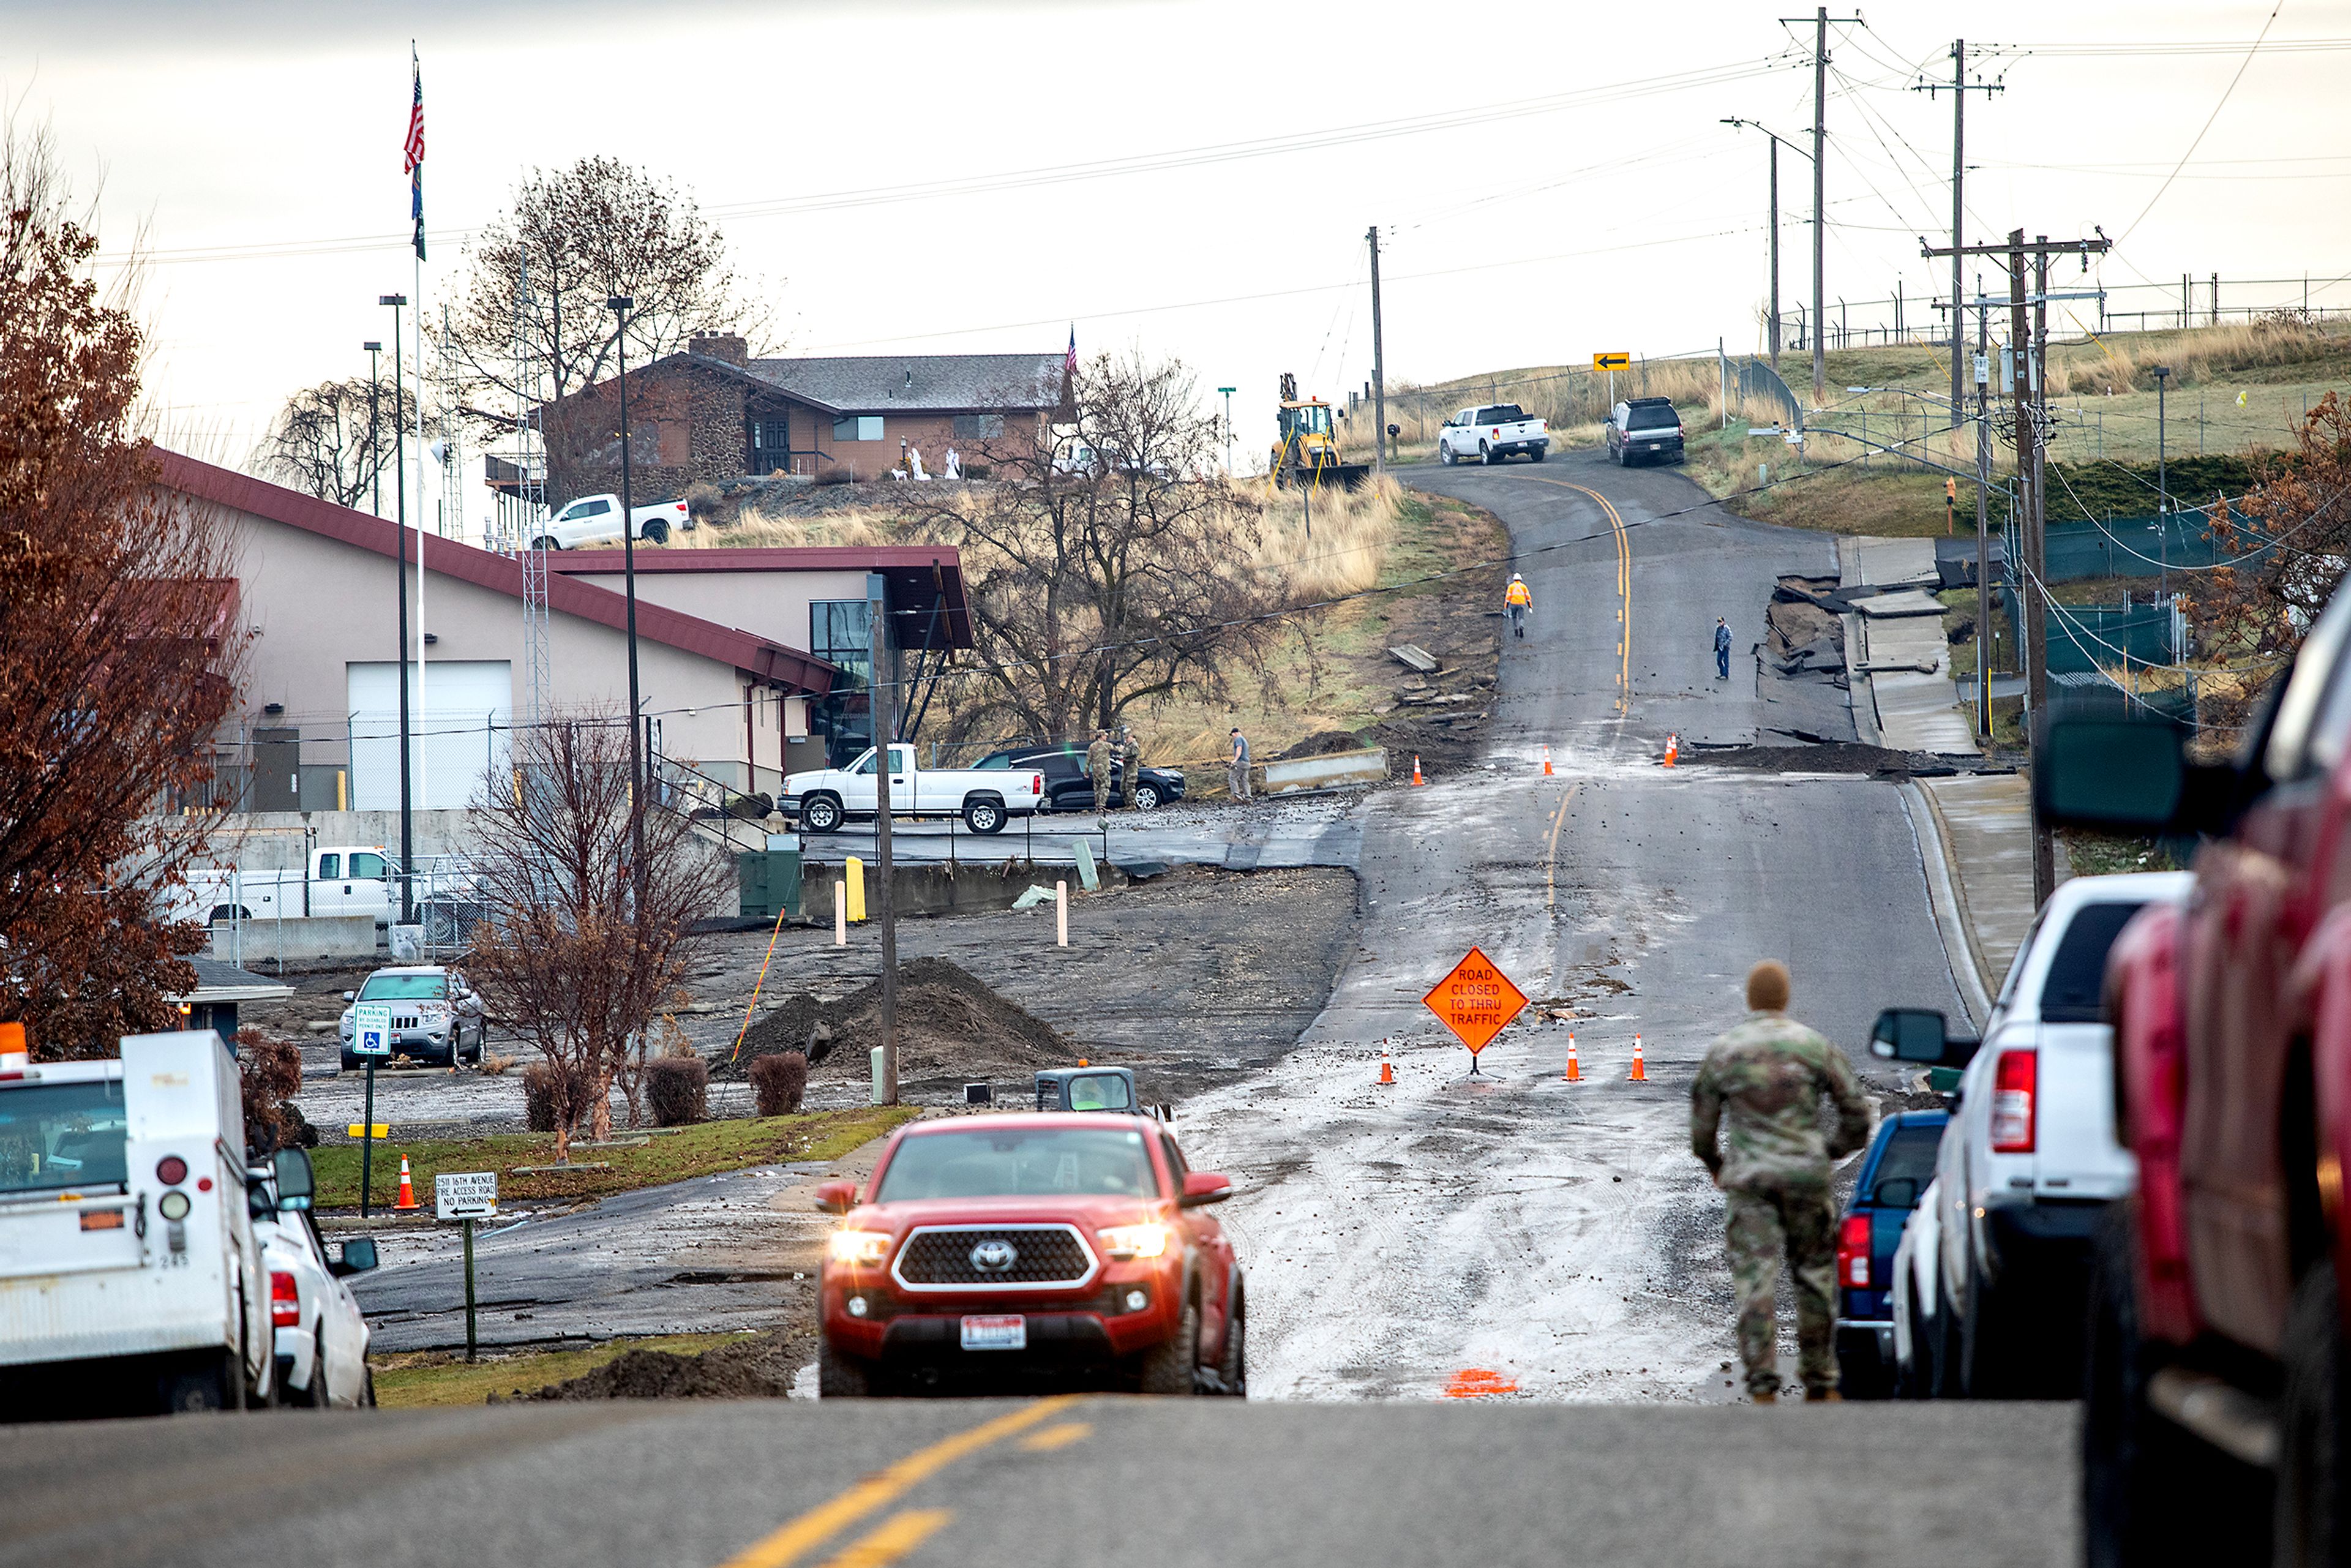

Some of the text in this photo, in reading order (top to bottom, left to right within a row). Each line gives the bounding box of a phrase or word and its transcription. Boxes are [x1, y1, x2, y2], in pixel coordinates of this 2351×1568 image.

[1459, 969, 1493, 980] ROAD
[1452, 985, 1499, 995] CLOSED
[1450, 999, 1501, 1010] TO THRU
[1450, 1013, 1501, 1025] TRAFFIC
[437, 1175, 493, 1187] 2511 16TH AVENUE
[437, 1185, 495, 1196] FIRE ACCESS ROAD
[443, 1195, 489, 1206] NO PARKING
